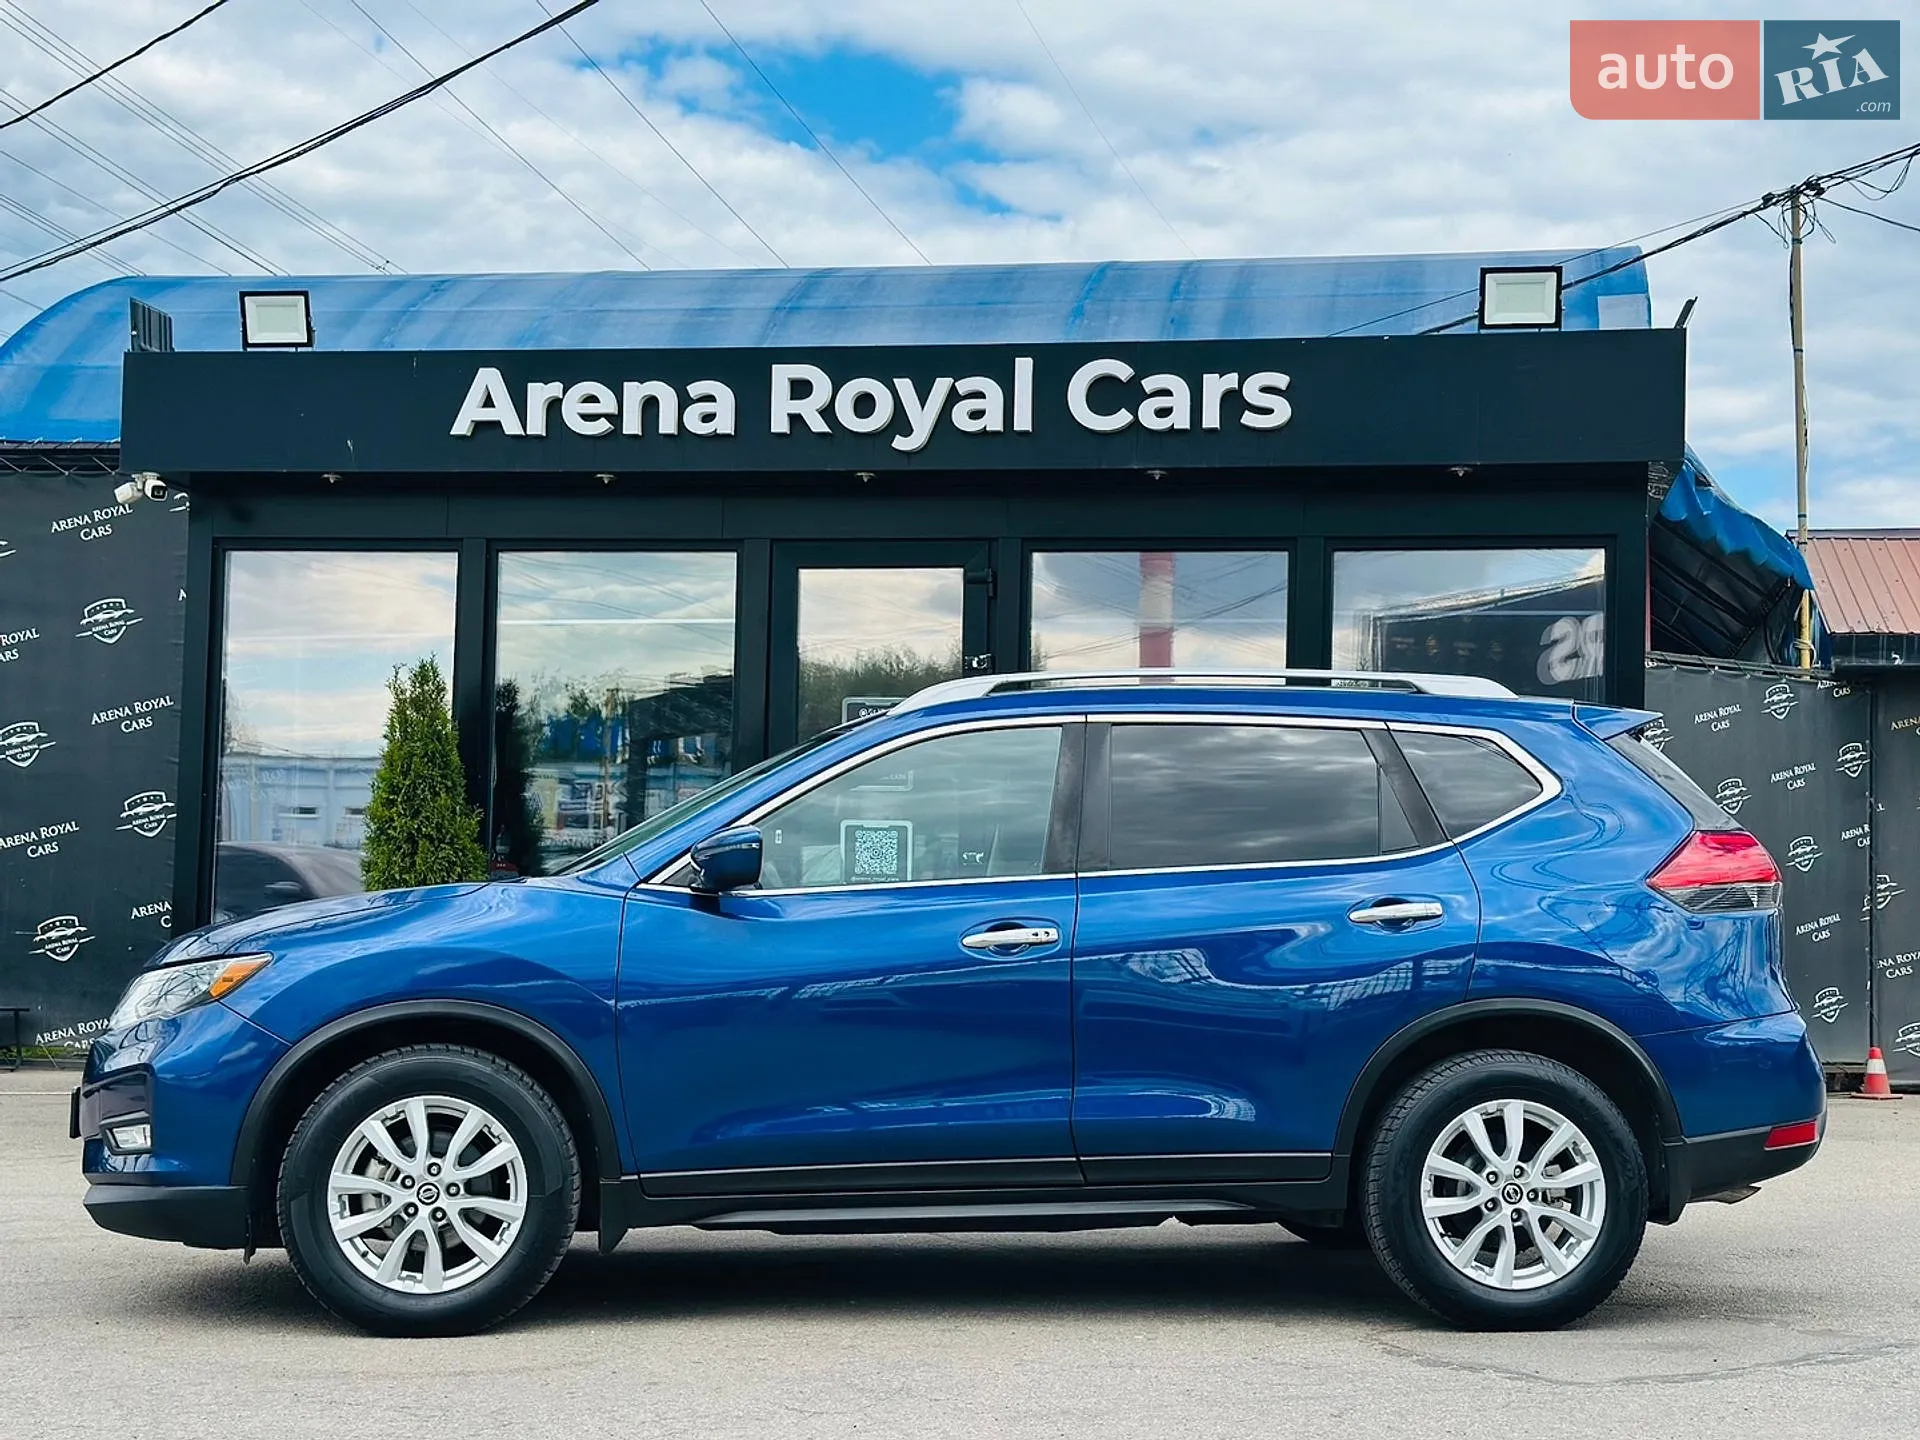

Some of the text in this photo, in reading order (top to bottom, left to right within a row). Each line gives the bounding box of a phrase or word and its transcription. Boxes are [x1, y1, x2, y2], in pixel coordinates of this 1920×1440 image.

[450, 357, 1292, 453] Arena Royal Cars
[51, 503, 133, 533] ARENA ROYAL
[80, 524, 112, 541] CARS
[1, 628, 40, 646] ROYAL
[91, 695, 174, 725] ARENA ROYAL
[1694, 704, 1742, 725] ARENA ROYAL
[121, 716, 153, 733] CARS
[40, 820, 80, 839] ROYAL
[27, 842, 59, 858] CARS
[1886, 965, 1913, 978] CARS
